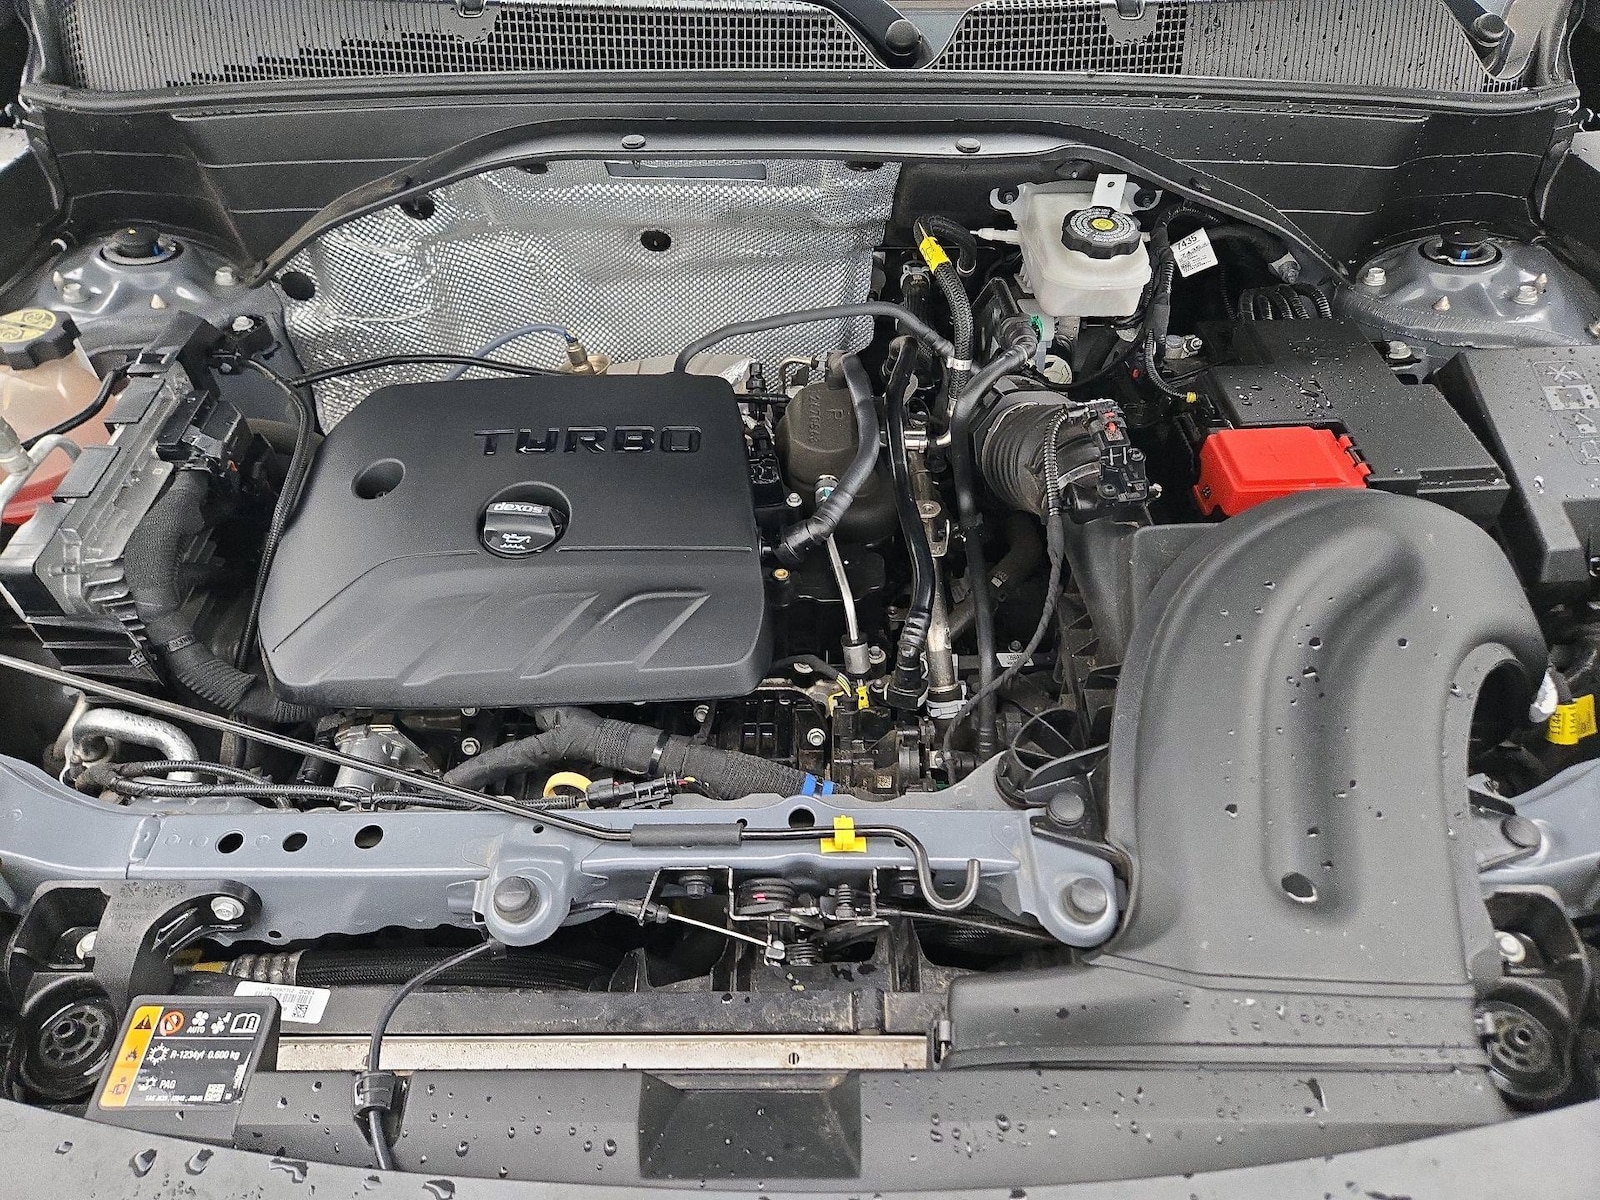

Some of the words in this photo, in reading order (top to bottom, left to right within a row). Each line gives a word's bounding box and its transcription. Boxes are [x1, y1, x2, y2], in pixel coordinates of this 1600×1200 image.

[1175, 233, 1198, 251] 7435
[474, 425, 702, 456] TURBO
[493, 501, 544, 514] dexos
[186, 1026, 206, 1034] AUTO
[169, 1050, 206, 1061] R-1234yf
[207, 1050, 229, 1060] 0.600
[229, 1050, 241, 1061] kg
[159, 1079, 177, 1090] PAG
